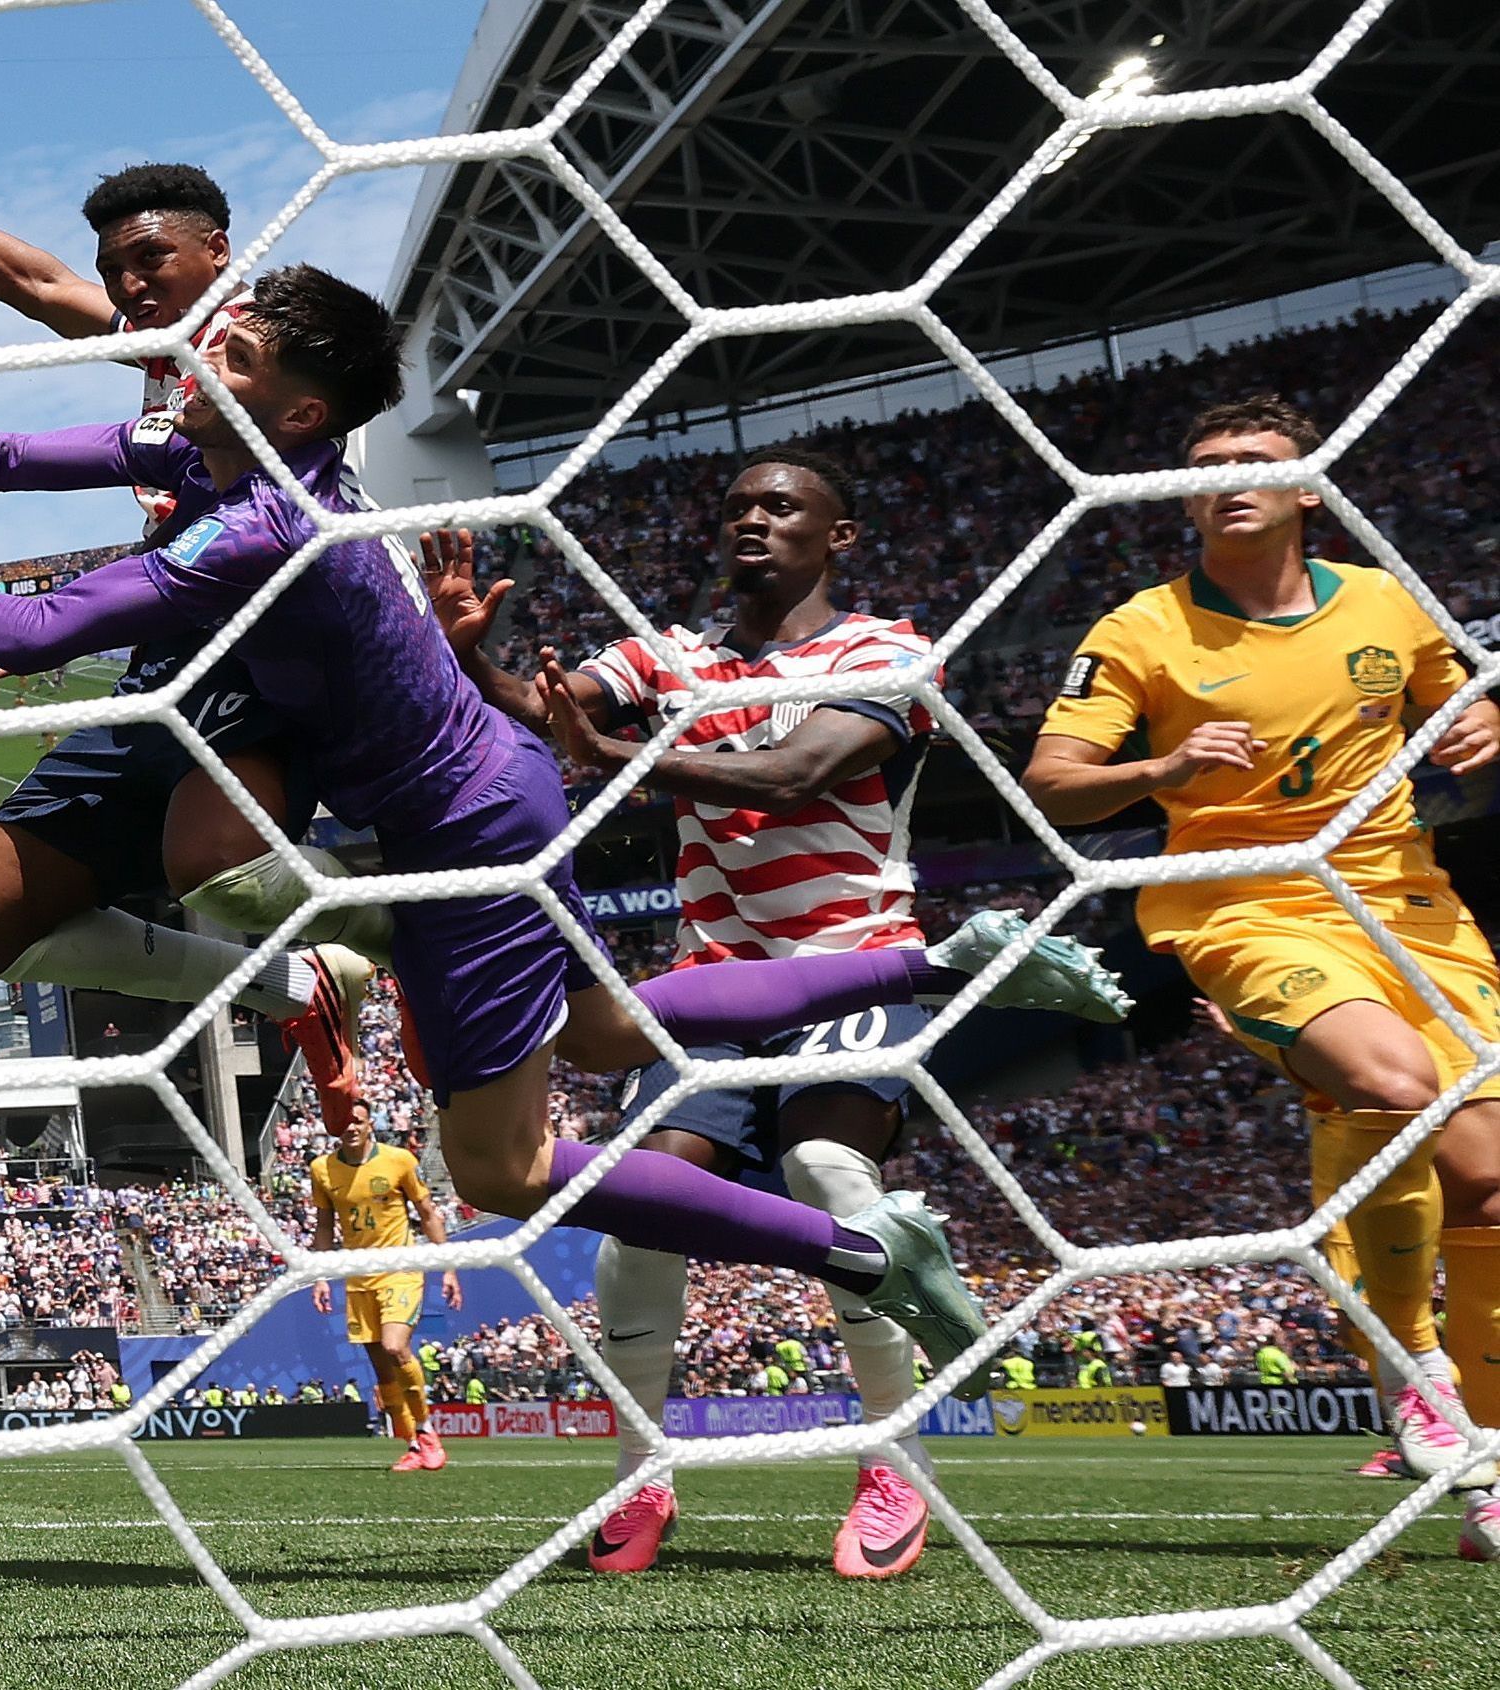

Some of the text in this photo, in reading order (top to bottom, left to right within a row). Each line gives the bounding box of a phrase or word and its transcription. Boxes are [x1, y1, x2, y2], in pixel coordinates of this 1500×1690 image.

[11, 580, 37, 595] AUS
[1279, 735, 1322, 798] 3
[581, 894, 619, 916] FA
[800, 1005, 888, 1057] 20
[350, 1206, 377, 1232] 24
[432, 1408, 482, 1435] tano
[935, 1397, 994, 1433] VISA
[1032, 1396, 1117, 1423] mercado
[1186, 1386, 1384, 1433] MARRIOTT
